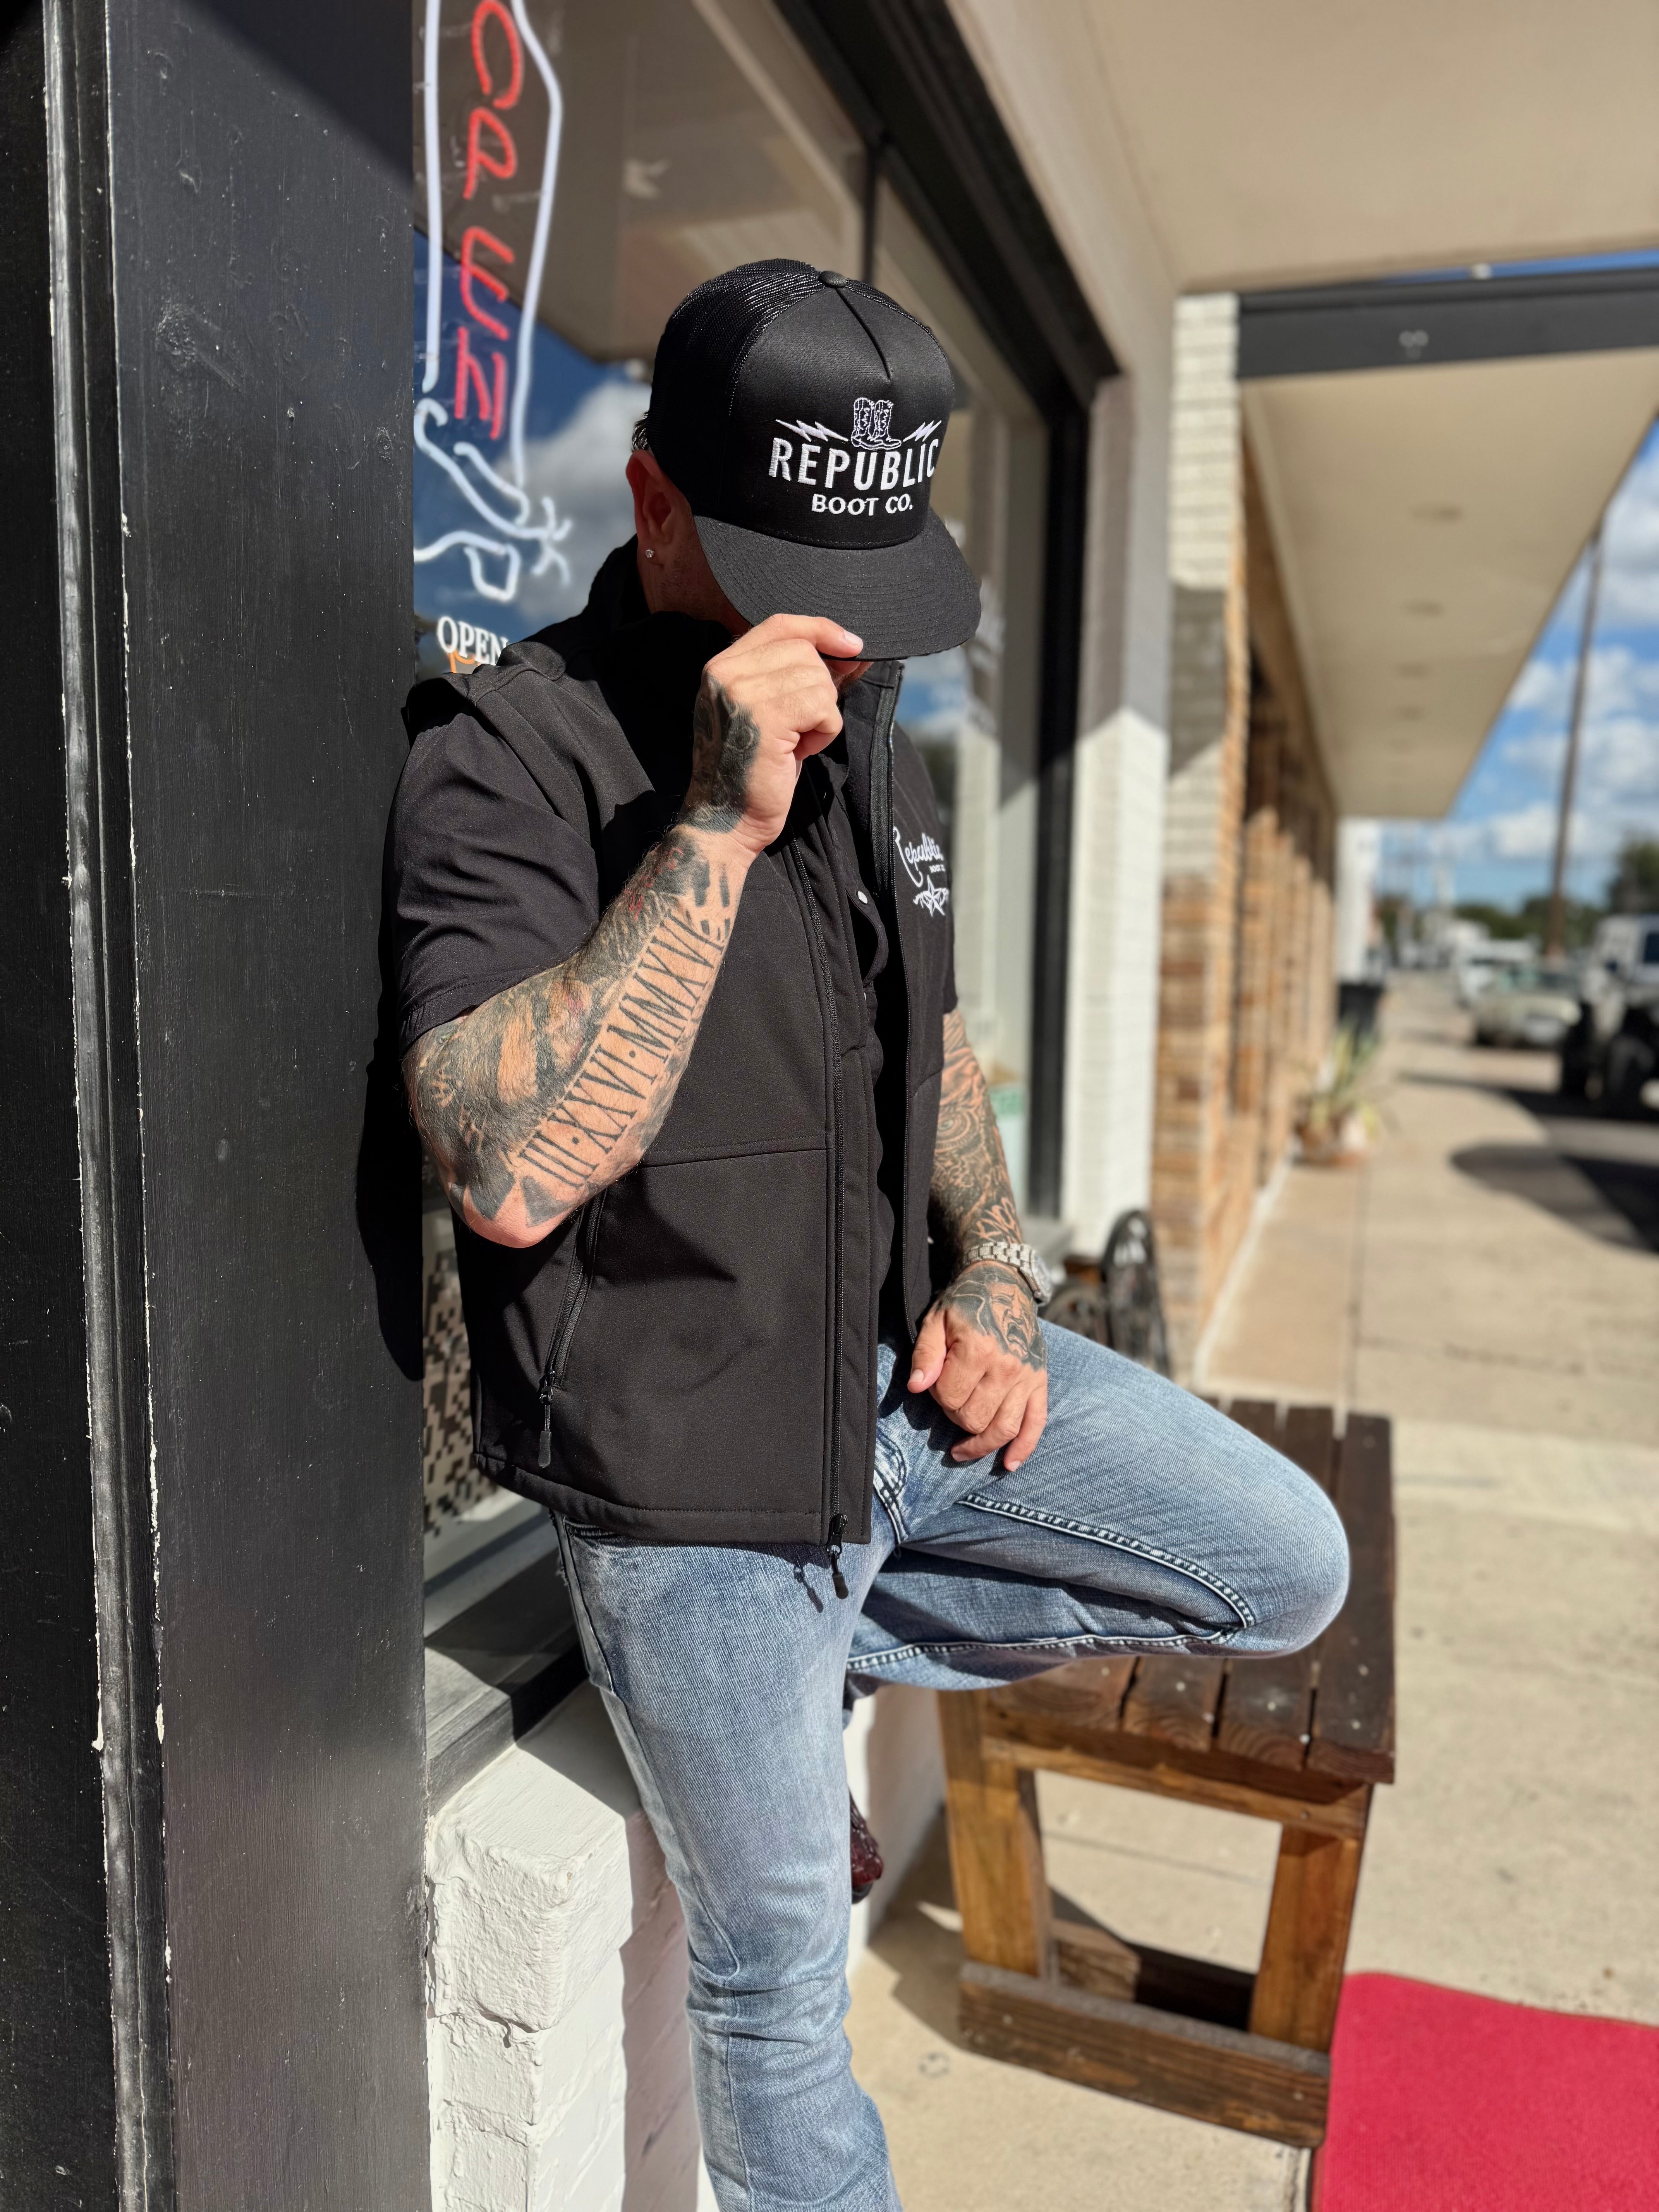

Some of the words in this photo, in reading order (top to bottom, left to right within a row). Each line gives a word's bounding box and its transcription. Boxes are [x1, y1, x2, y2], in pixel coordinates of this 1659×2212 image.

[768, 437, 939, 491] REPUBLIC
[811, 493, 878, 516] BOOT
[885, 493, 913, 514] CO.
[437, 616, 509, 666] OPEN
